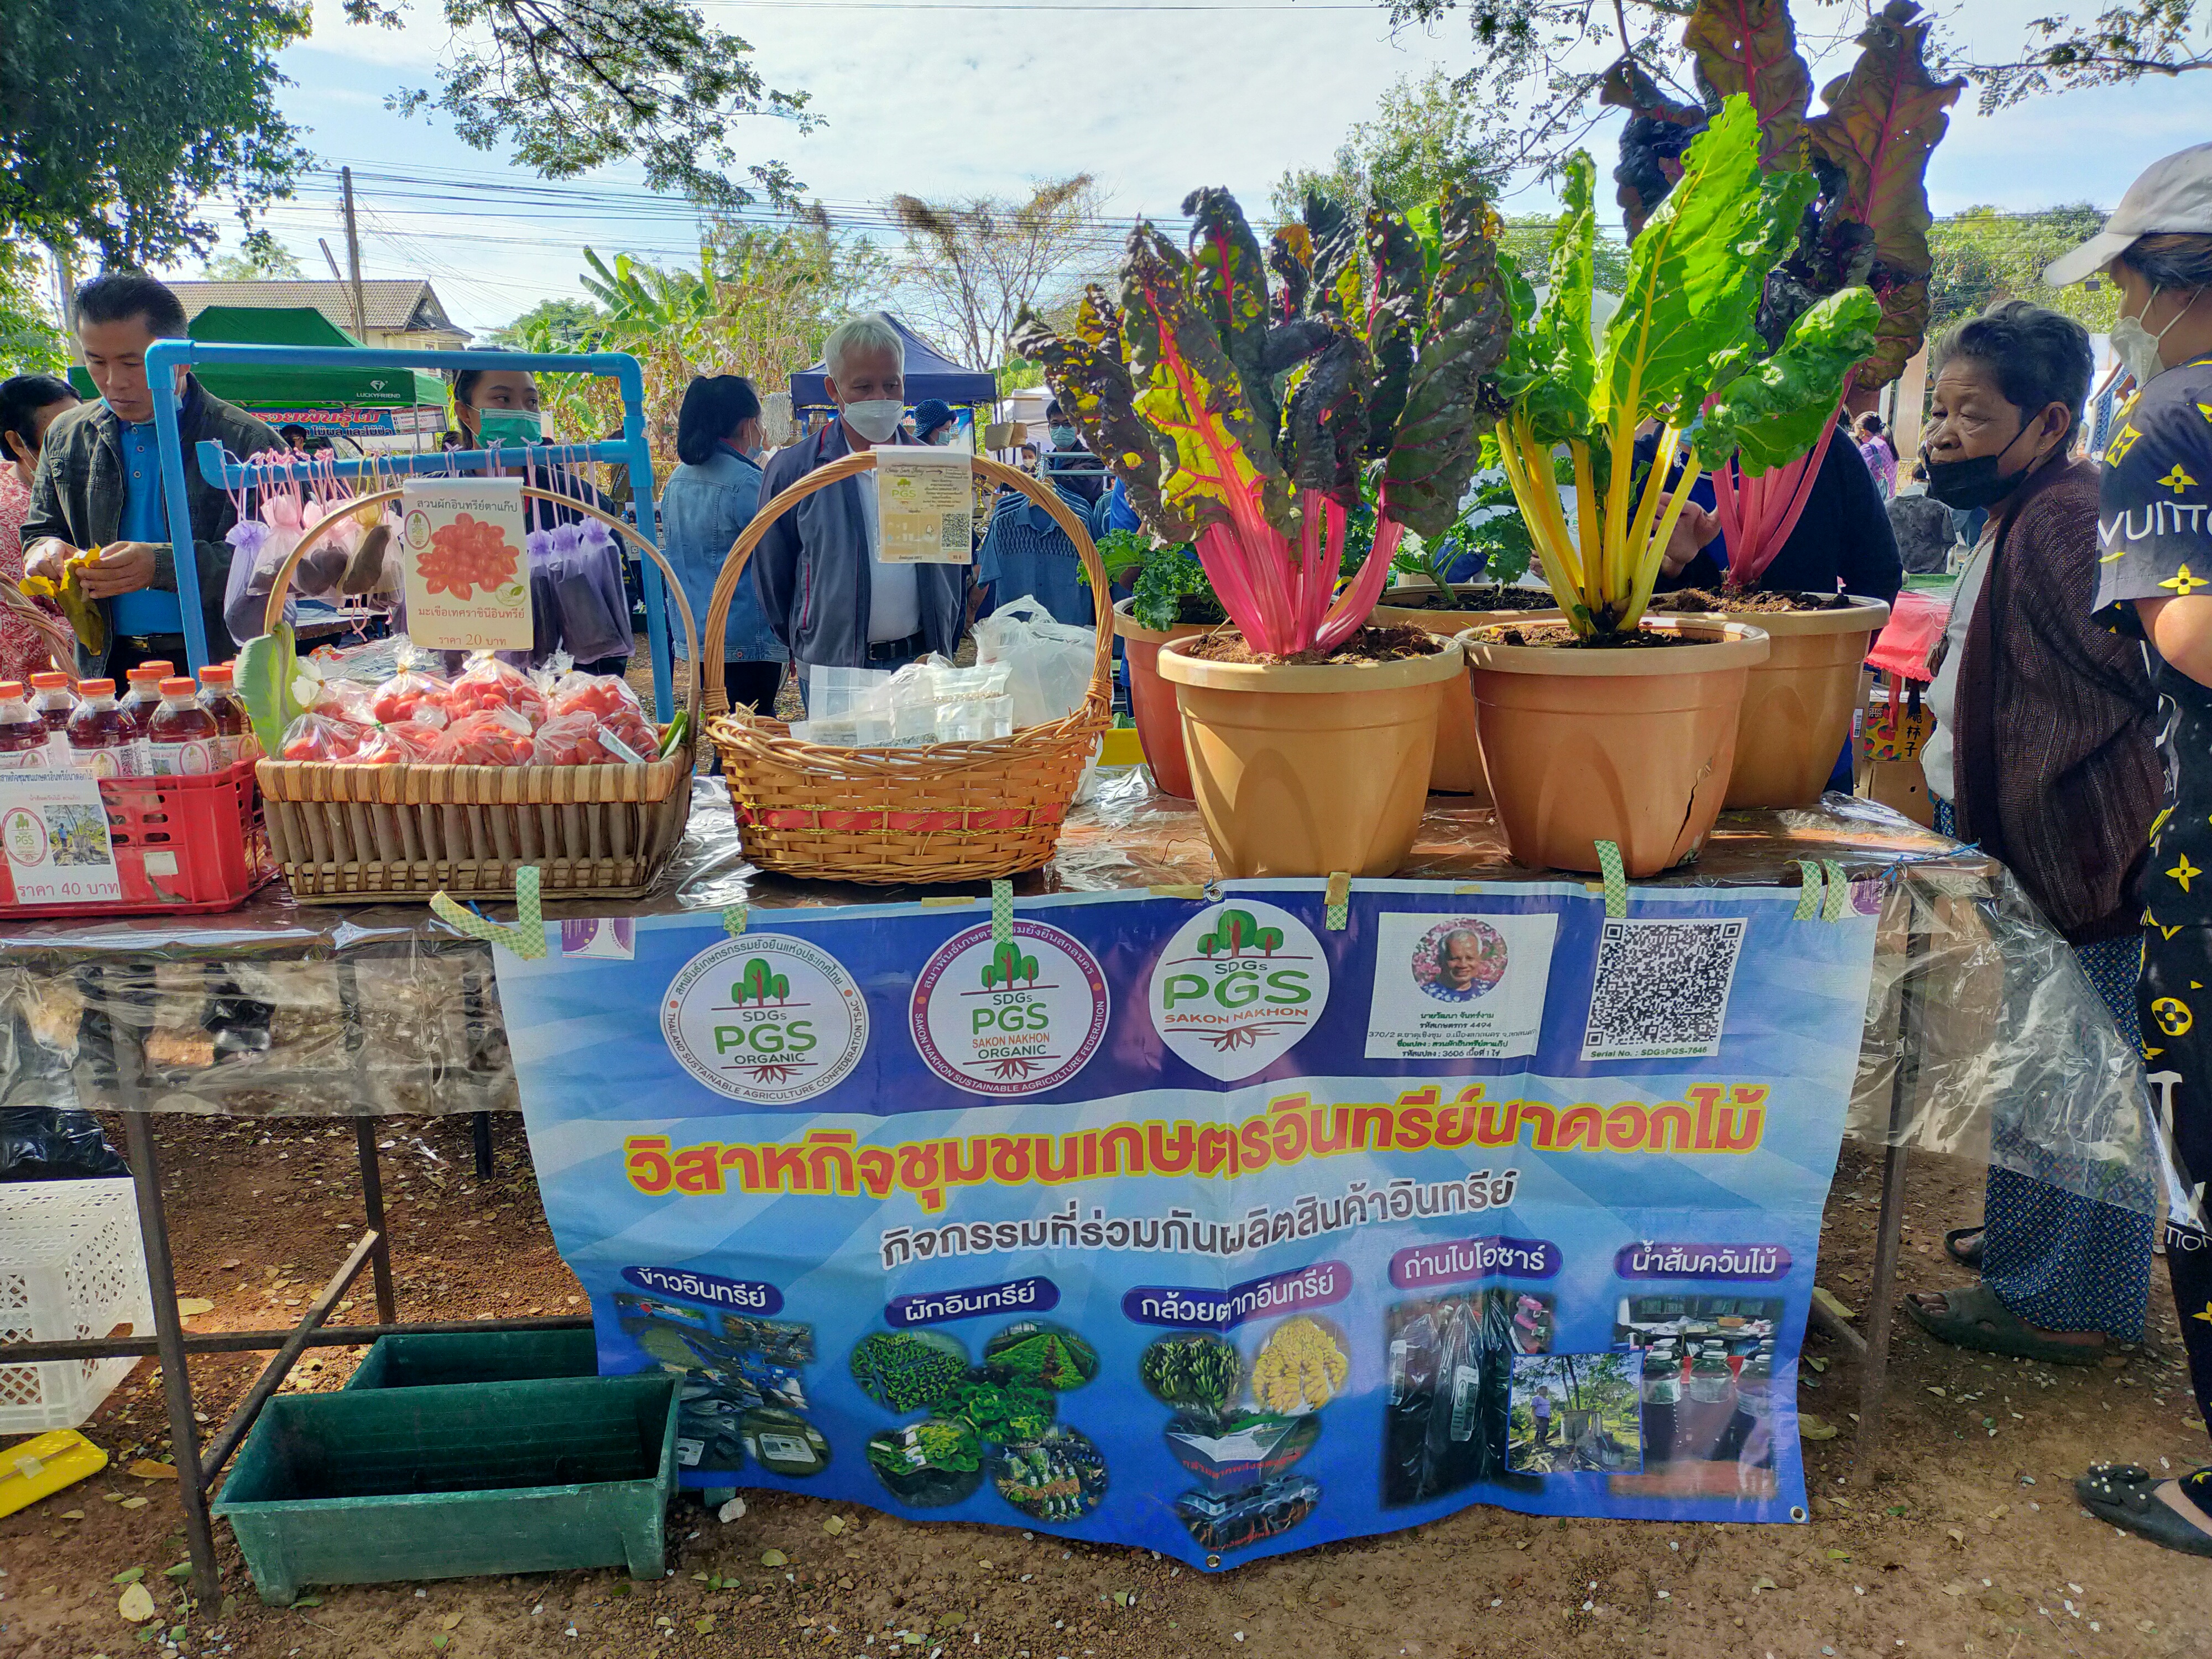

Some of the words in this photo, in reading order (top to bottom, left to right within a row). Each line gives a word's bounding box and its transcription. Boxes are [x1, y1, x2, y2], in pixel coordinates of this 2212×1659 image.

[2098, 501, 2212, 547] VUITT
[418, 606, 525, 619] มะเขือเทศราชินีอินทรีย์
[439, 635, 461, 645] ราคา
[466, 634, 482, 645] 20
[486, 637, 506, 646] บาท
[15, 835, 34, 845] PGS
[17, 885, 54, 897] ราคา
[61, 883, 81, 895] 40
[87, 883, 119, 895] บาท
[1214, 961, 1267, 974] SDGs
[993, 992, 1032, 1005] SDGs
[1164, 970, 1311, 1009] PGS
[743, 1010, 787, 1022] SDGs
[972, 1003, 1049, 1035] PGS
[1165, 1014, 1229, 1024] SAKON
[1234, 1008, 1308, 1021] NAKHON
[667, 1013, 685, 1052] THAILAND
[682, 1053, 740, 1094] SUSTAINABLE
[743, 1084, 816, 1099] AGRICULTURE
[816, 1025, 863, 1087] CONFEDERATION
[851, 1000, 862, 1023] TSAC
[714, 1020, 817, 1055] PGS
[915, 1013, 928, 1044] SAKON
[924, 1045, 954, 1077] NAKHON
[953, 1074, 1019, 1092] SUSTAINABLE
[1021, 1058, 1081, 1091] AGRICULTURE
[1080, 1000, 1104, 1058] FEDERATION
[972, 1035, 1006, 1049] SAKON
[1008, 1032, 1050, 1046] NAKHON
[978, 1044, 1046, 1058] ORGANIC
[1641, 1046, 1708, 1056] SDGsPGS-7646
[734, 1052, 806, 1065] ORGANIC
[625, 1085, 1769, 1211] วิสาหกิจชุมชนเกษตรอินทรีย์นาดอกไม้
[883, 1170, 1518, 1267] กิจกรรมที่ร่วมกันผลิตสินค้าอินทรีย์
[1405, 1243, 1545, 1279] ถ่านไบโอซาร์
[1632, 1240, 1776, 1274] น้ำส้มควันไม้
[637, 1267, 766, 1308] ข้าวอินทรีย์
[905, 1280, 1036, 1322] ผักอินทรีย์
[1141, 1266, 1334, 1322] กล้วยตากอินทรีย์
